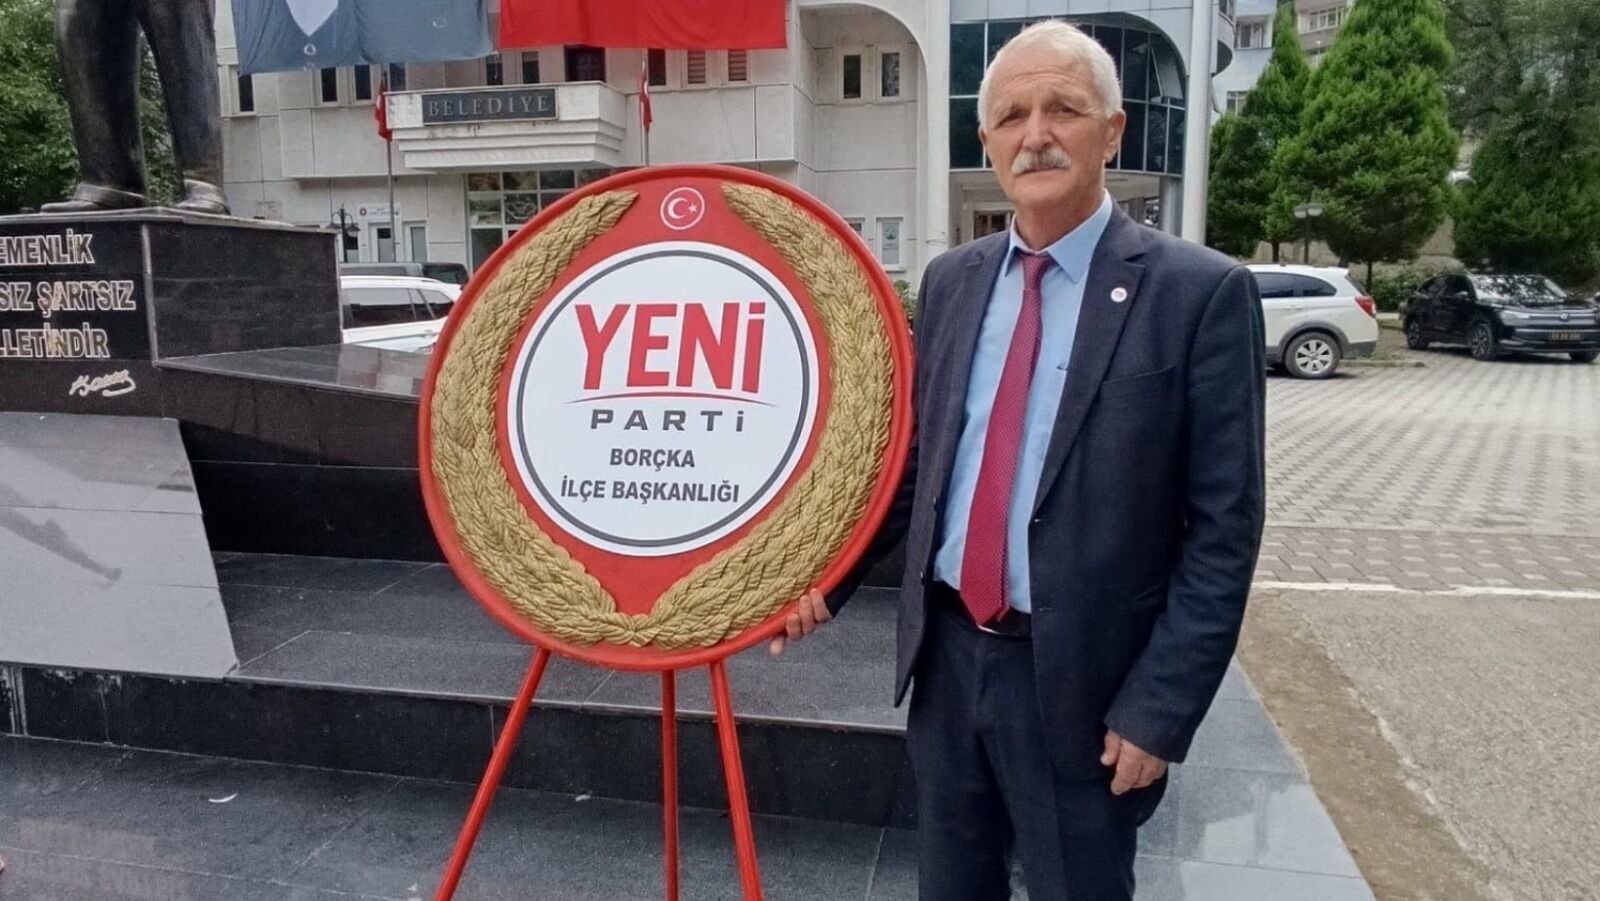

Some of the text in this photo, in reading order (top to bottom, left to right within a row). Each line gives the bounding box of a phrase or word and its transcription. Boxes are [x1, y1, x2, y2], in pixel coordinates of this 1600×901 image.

[428, 92, 549, 117] BELEDİYE
[37, 279, 137, 318] ŞARTSIZ
[574, 301, 767, 394] YENİ
[590, 408, 745, 433] PARTİ
[609, 447, 696, 473] BORÇKA
[560, 475, 740, 506] İLÇE BAŞKANLIĞI
